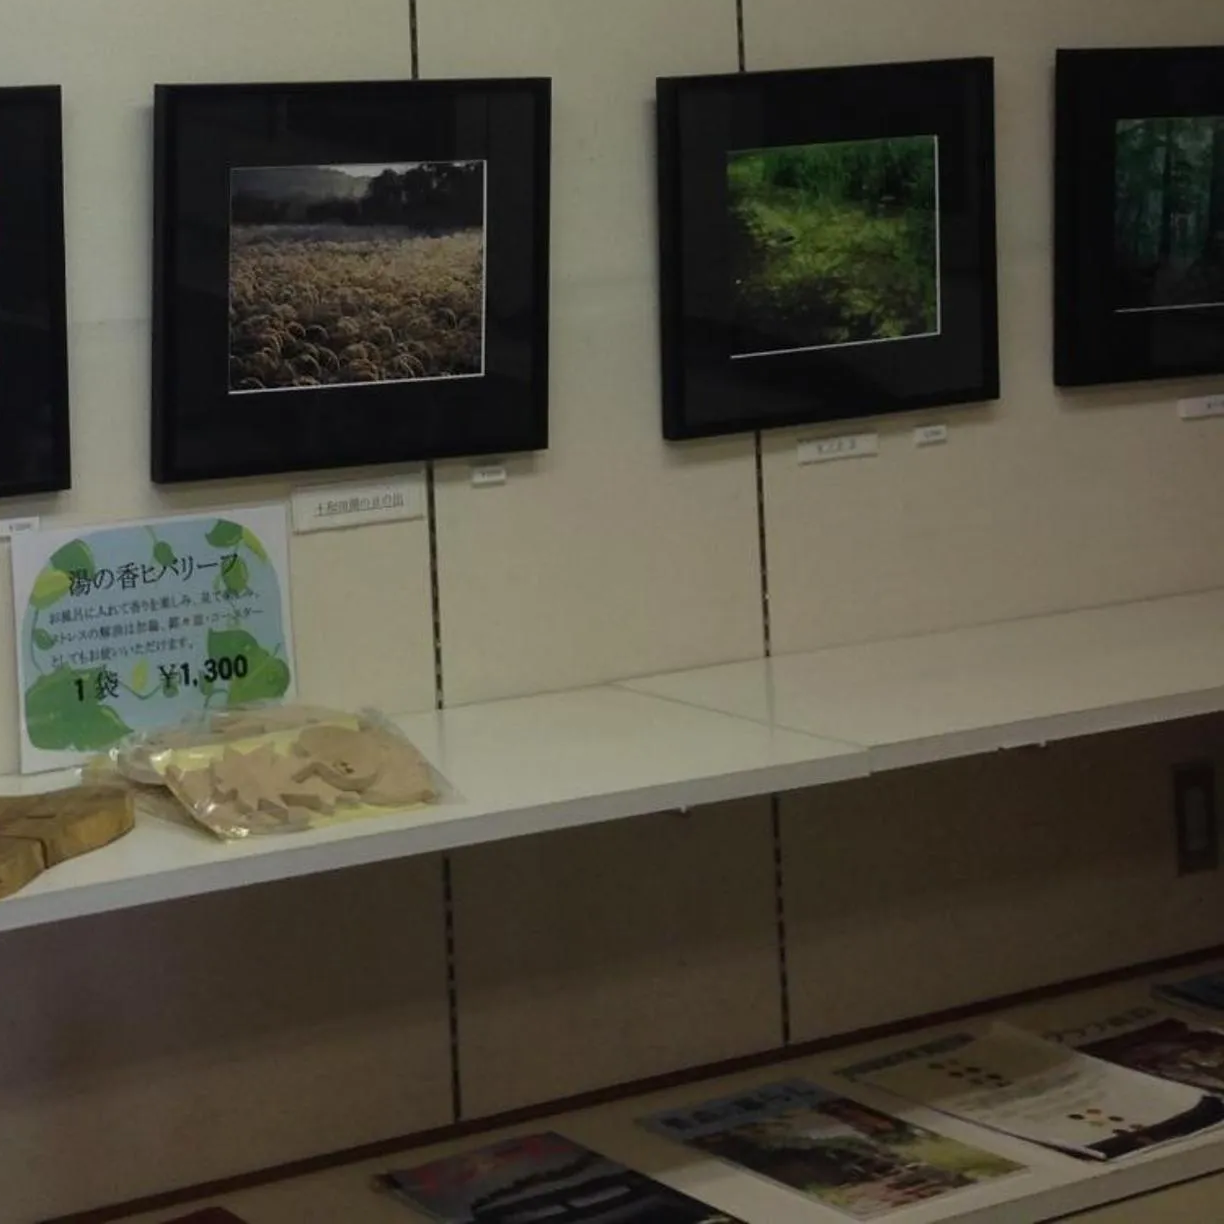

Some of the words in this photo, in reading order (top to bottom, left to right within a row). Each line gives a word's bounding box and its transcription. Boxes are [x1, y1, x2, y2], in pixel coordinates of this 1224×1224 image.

[69, 553, 238, 597] 湯の香ヒバリーフ
[158, 654, 249, 689] ¥1,300
